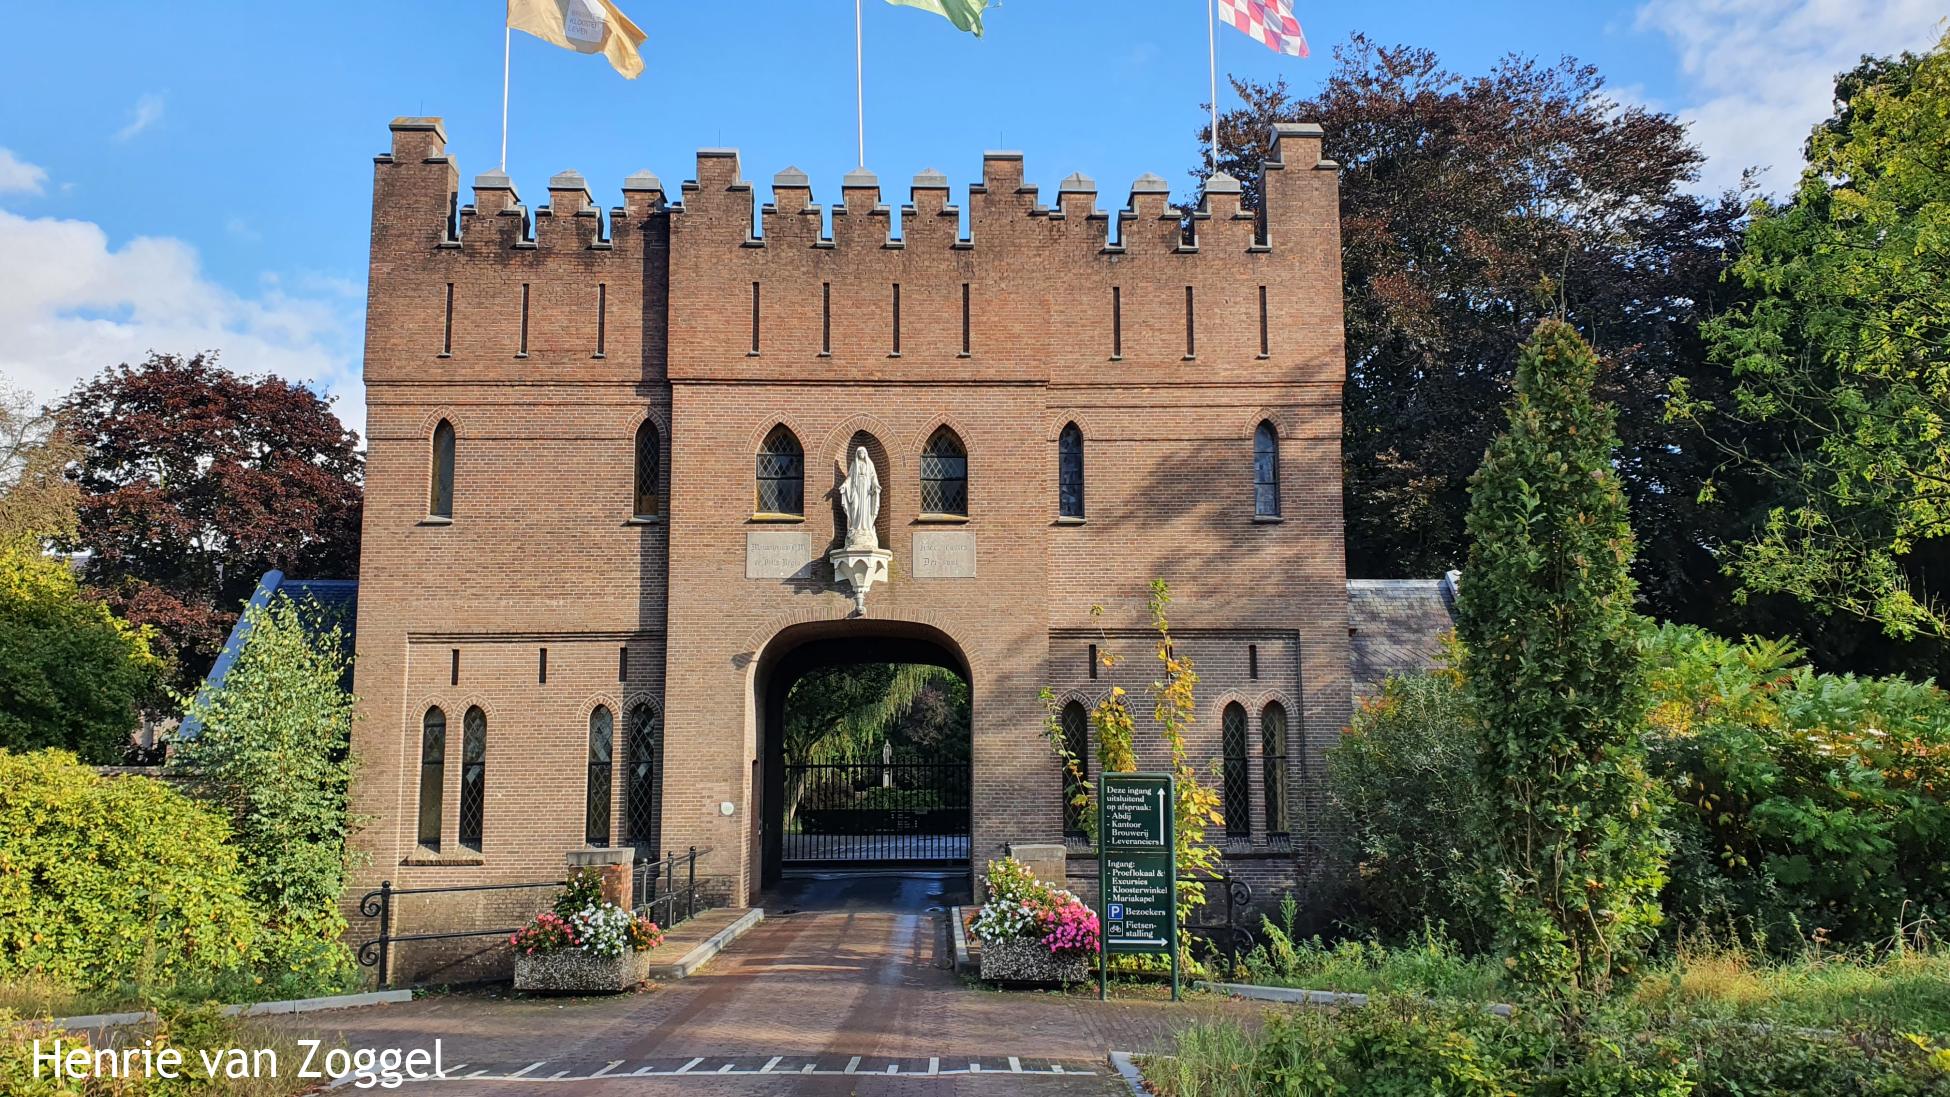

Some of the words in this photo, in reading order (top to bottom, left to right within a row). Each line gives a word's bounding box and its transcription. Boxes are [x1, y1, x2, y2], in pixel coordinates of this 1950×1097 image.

[1107, 786, 1126, 794] Deze
[1127, 787, 1152, 796] ingang
[1117, 803, 1152, 812] afspraak:
[1112, 812, 1132, 820] Abdij
[1112, 829, 1149, 839] Brouwerij
[1112, 837, 1160, 845] Leveranciers
[1108, 860, 1136, 868] Ingang:
[1112, 894, 1154, 903] Mariakapel
[1112, 906, 1120, 918] P
[1126, 930, 1154, 938] stalling
